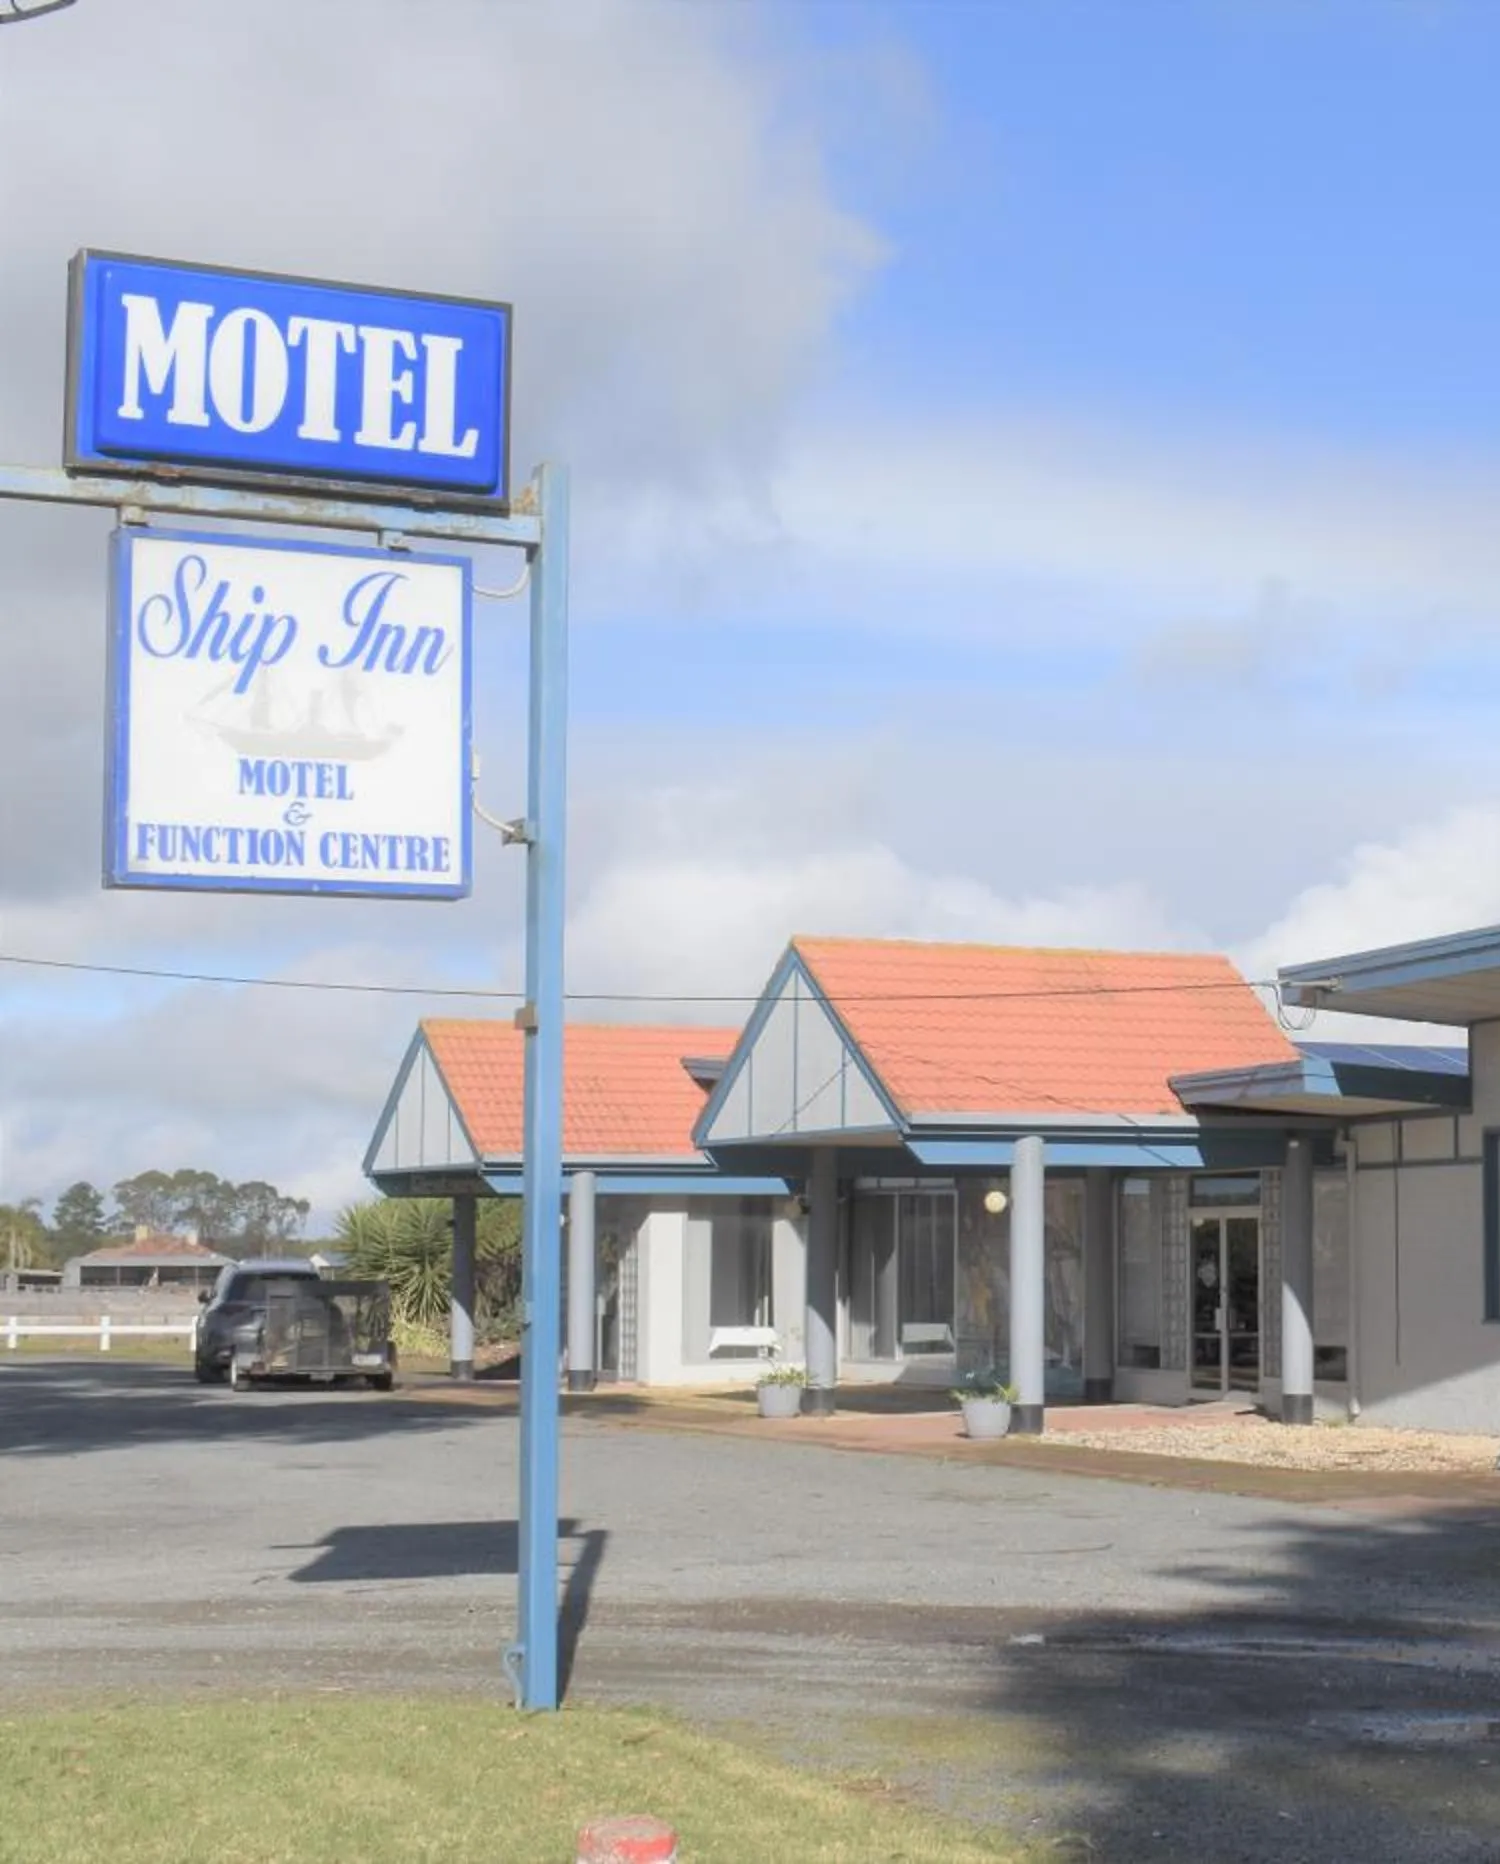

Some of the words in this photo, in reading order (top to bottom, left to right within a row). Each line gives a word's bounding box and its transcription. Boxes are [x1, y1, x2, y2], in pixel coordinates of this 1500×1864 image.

[117, 293, 479, 458] MOTEL
[137, 555, 297, 694] Ship
[318, 571, 454, 675] Inn
[238, 758, 354, 800] MOTEL
[283, 802, 312, 826] &
[135, 822, 305, 867] FUNCTION
[319, 831, 450, 873] CENTRE
